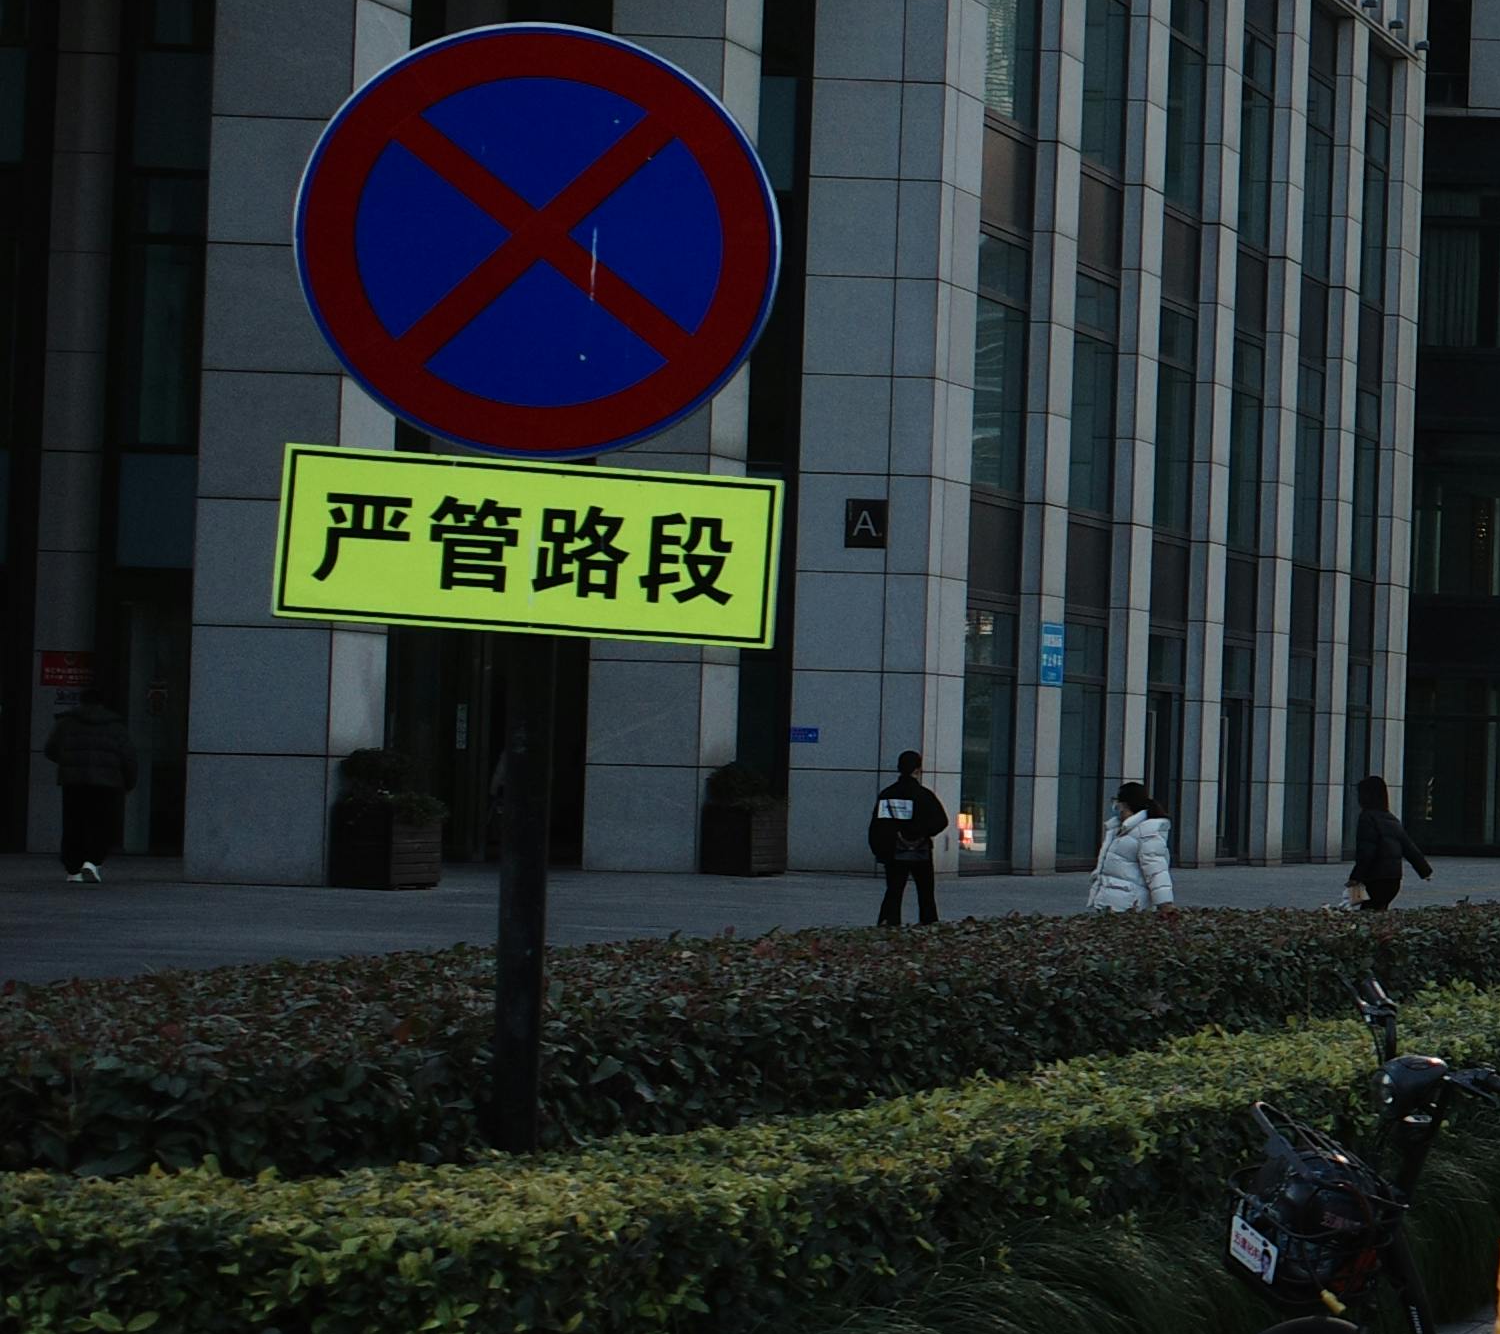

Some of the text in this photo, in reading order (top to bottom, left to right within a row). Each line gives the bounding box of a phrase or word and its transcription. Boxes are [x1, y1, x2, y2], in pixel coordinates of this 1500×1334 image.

[312, 492, 734, 606] 严管路段
[852, 510, 877, 537] A
